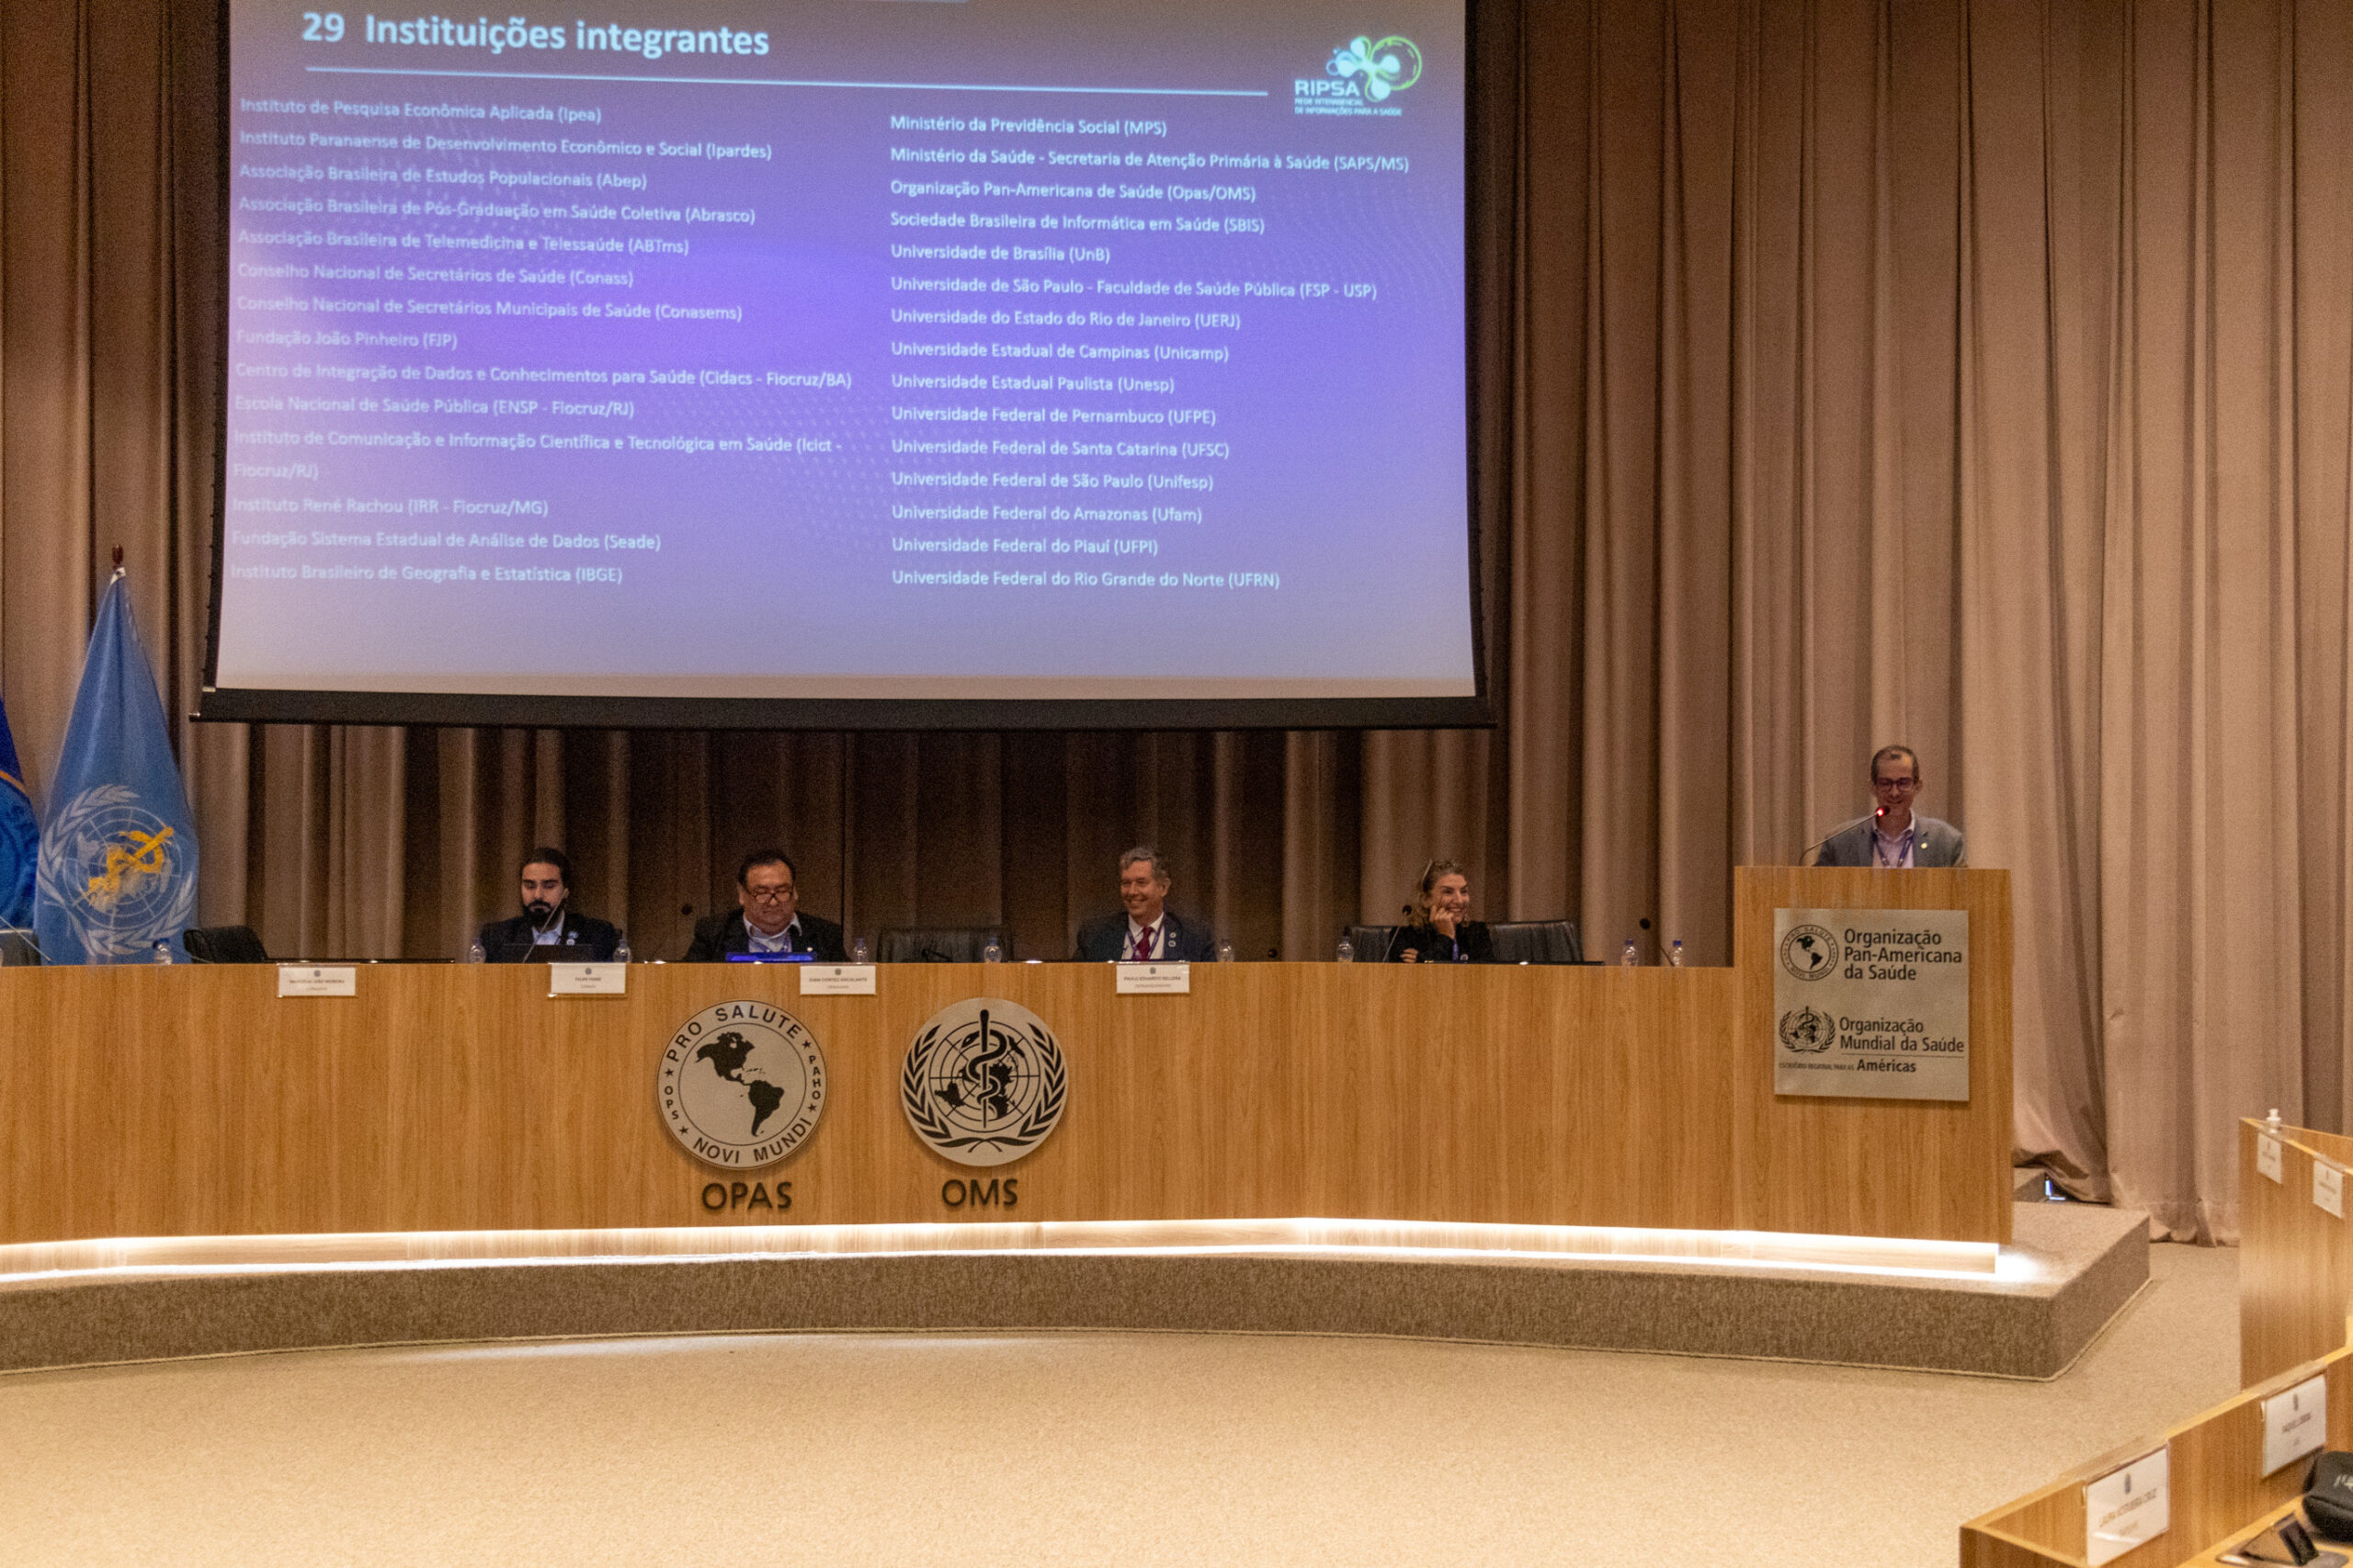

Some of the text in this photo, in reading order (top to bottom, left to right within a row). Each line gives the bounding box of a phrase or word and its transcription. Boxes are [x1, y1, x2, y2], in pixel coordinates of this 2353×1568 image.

[301, 12, 769, 59] 29 Instituições integrantes
[1294, 79, 1360, 97] RIPSA
[891, 116, 1167, 137] Ministério da Previdência Social (MPS)
[891, 180, 1256, 203] Organização Pan-Americana de Saúde (Opas/OMS)
[891, 212, 1265, 234] Sociedade Brasileira de Informática em Saúde (SBIS)
[891, 244, 1110, 264] Universidade de Brasília (UnB)
[891, 310, 1241, 329] Universidade do Estado do Rio de Janeiro (UERJ)
[892, 342, 1229, 362] Universidade Estadual de Campinas (Unicamp)
[892, 374, 1175, 393] Universidade Estadual Paulista (Unesp)
[892, 406, 1216, 426] Universidade Federal de Pernambuco (UFPE)
[892, 439, 1230, 459] Universidade Federal de Santa Catarina (UFSC)
[891, 472, 1214, 490] Universidade Federal de São Paulo (Unifesp)
[892, 506, 1202, 523] Universidade Federal do Amazonas (Ufam)
[892, 538, 1158, 555] Universidade Federal do Piauí (UFPI)
[892, 571, 1280, 588] Universidade Federal do Rio Grande do Norte (UFRN)
[1844, 928, 1942, 949] Organização
[1844, 946, 1962, 963] Pan-Americana
[1844, 964, 1863, 980] da
[1869, 965, 1916, 981] Saúde
[666, 1005, 801, 1062] PRO SALUTE
[1839, 1017, 1924, 1036] Organização
[1840, 1035, 1965, 1052] Mundial da Saúde
[1857, 1059, 1916, 1073] Américas
[808, 1055, 821, 1100] PAHO
[664, 1085, 679, 1120] OPS
[693, 1117, 813, 1164] NOVI MUNDI
[701, 1182, 792, 1210] OPAS
[942, 1178, 1018, 1207] OMS
